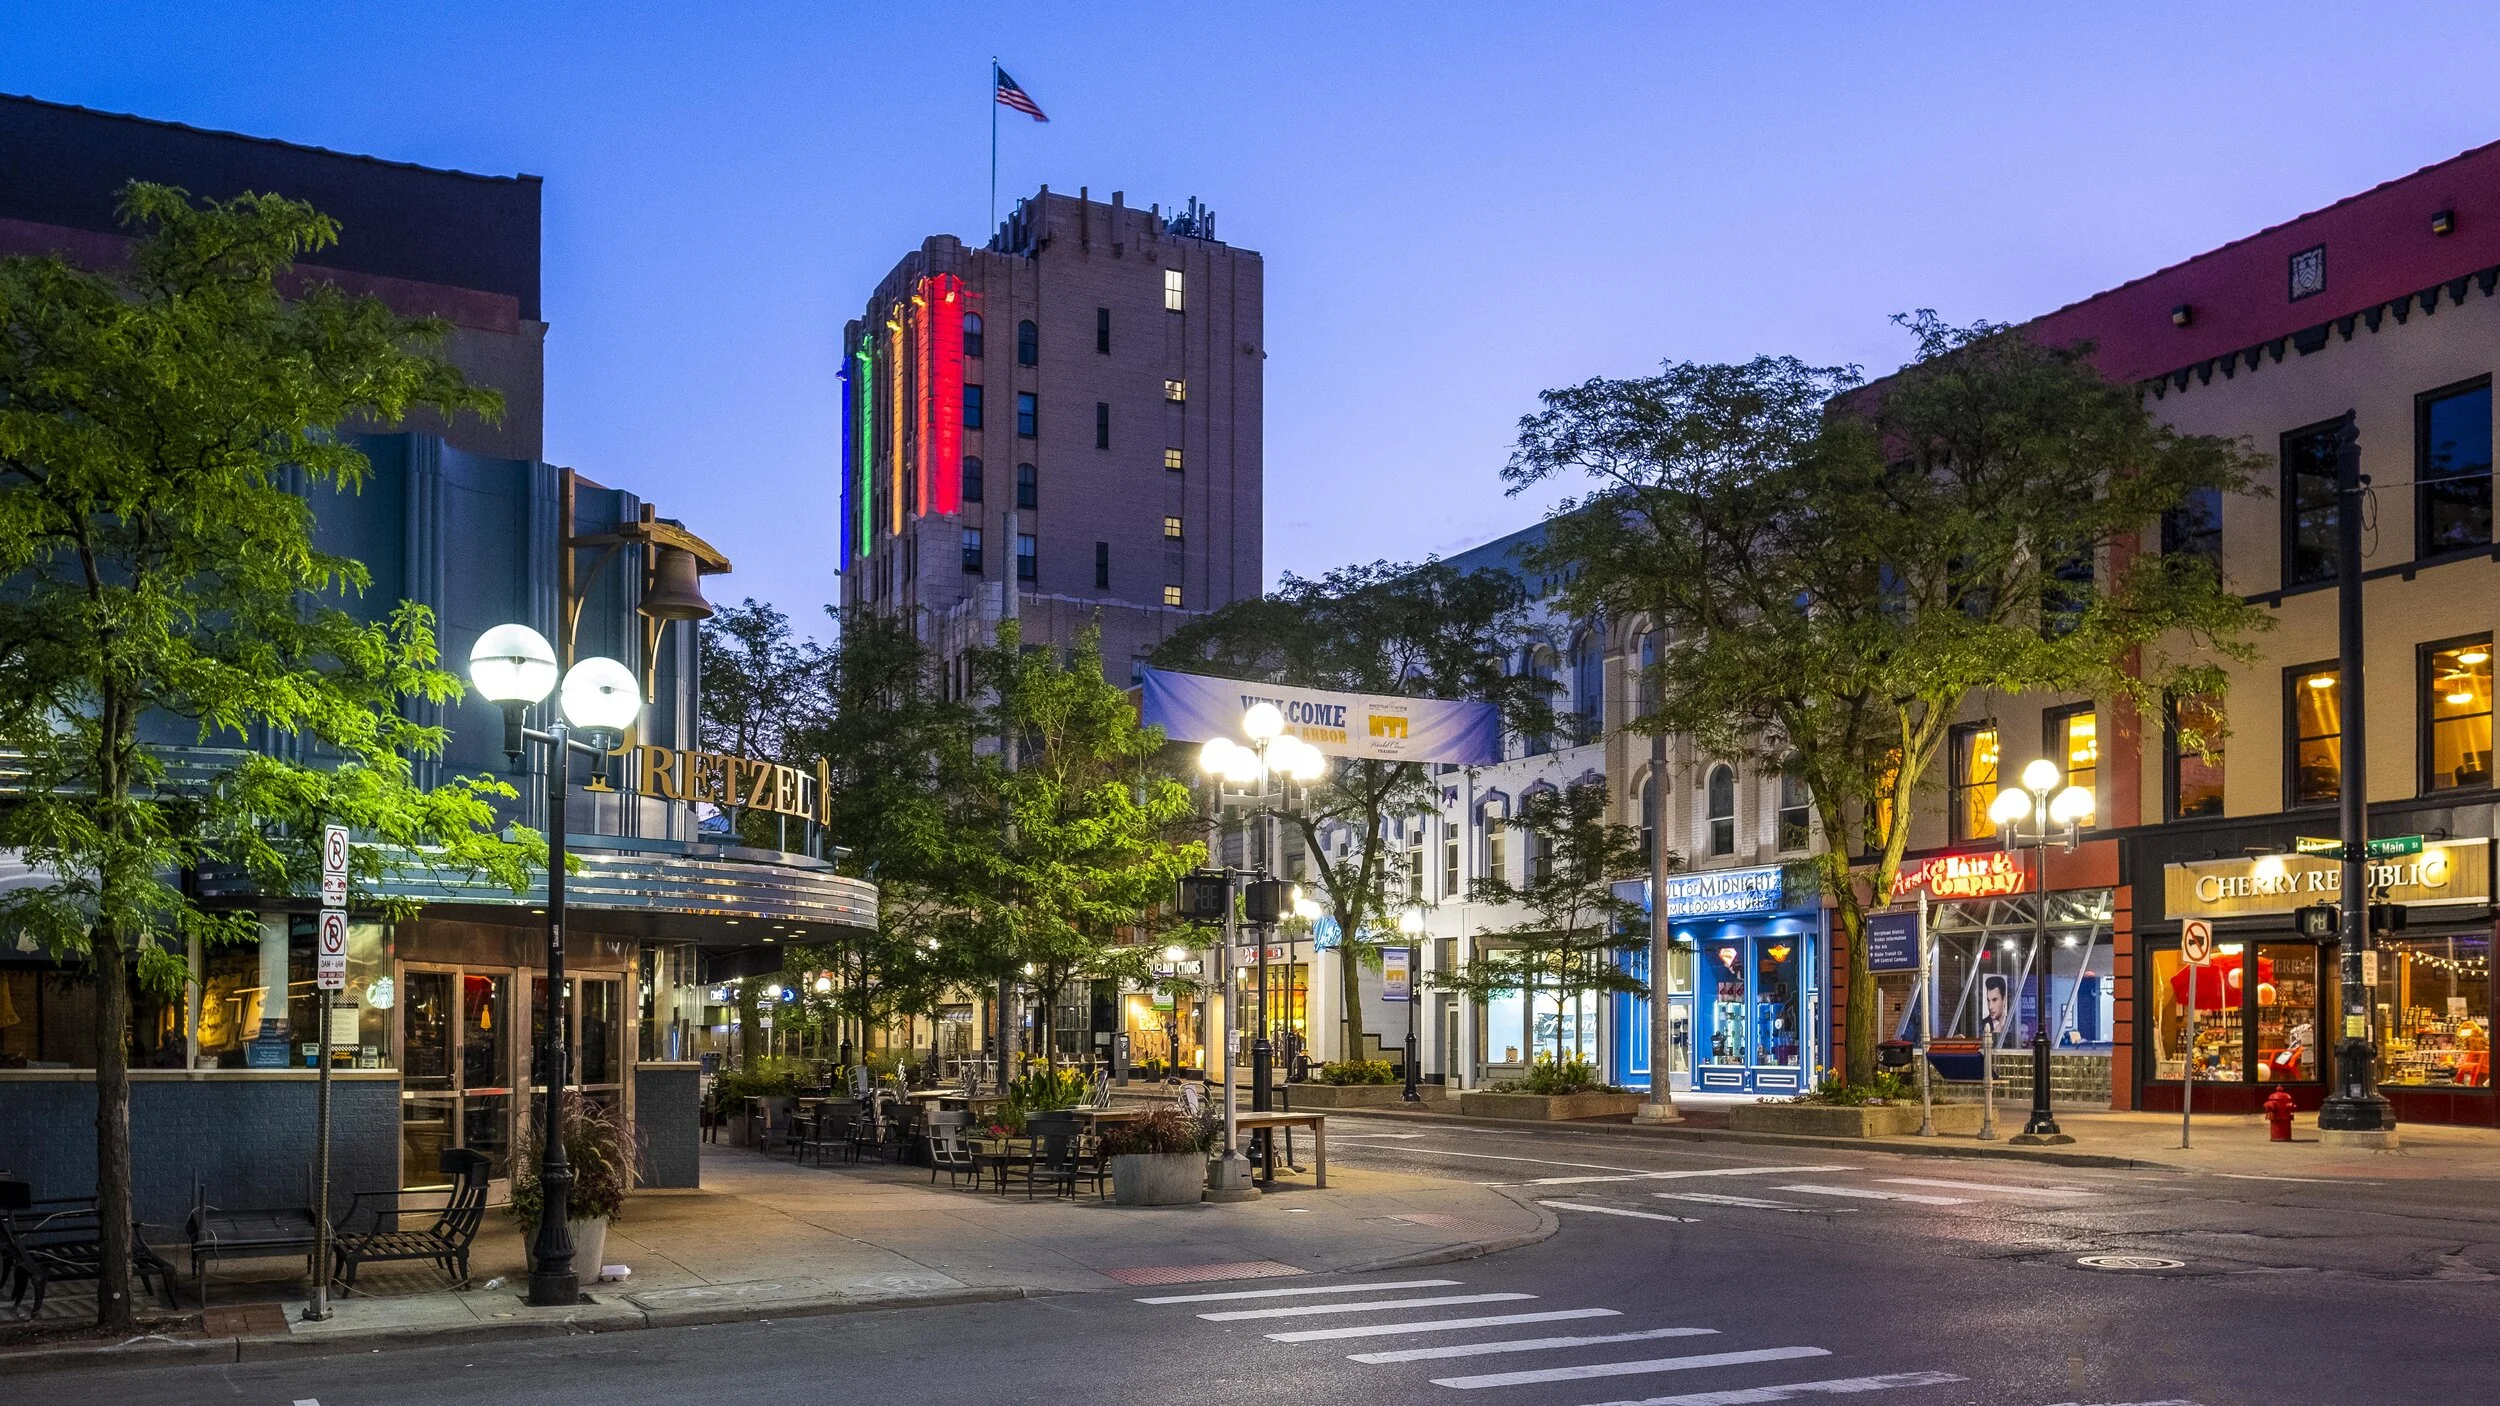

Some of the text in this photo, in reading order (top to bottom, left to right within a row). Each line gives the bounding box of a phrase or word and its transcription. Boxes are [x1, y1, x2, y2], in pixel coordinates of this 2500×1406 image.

[1241, 695, 1347, 727] WLCOME
[1302, 726, 1347, 744] ARBOR
[1368, 714, 1408, 739] NTI
[2370, 841, 2419, 855] S. Main St
[1947, 857, 1988, 878] Hair
[1700, 874, 1773, 897] MIDNIGHT
[1931, 872, 2021, 896] Company
[2196, 859, 2447, 903] CHERRY REUBLIC
[1724, 900, 1730, 910] &
[1163, 960, 1200, 976] DIRCTIONS
